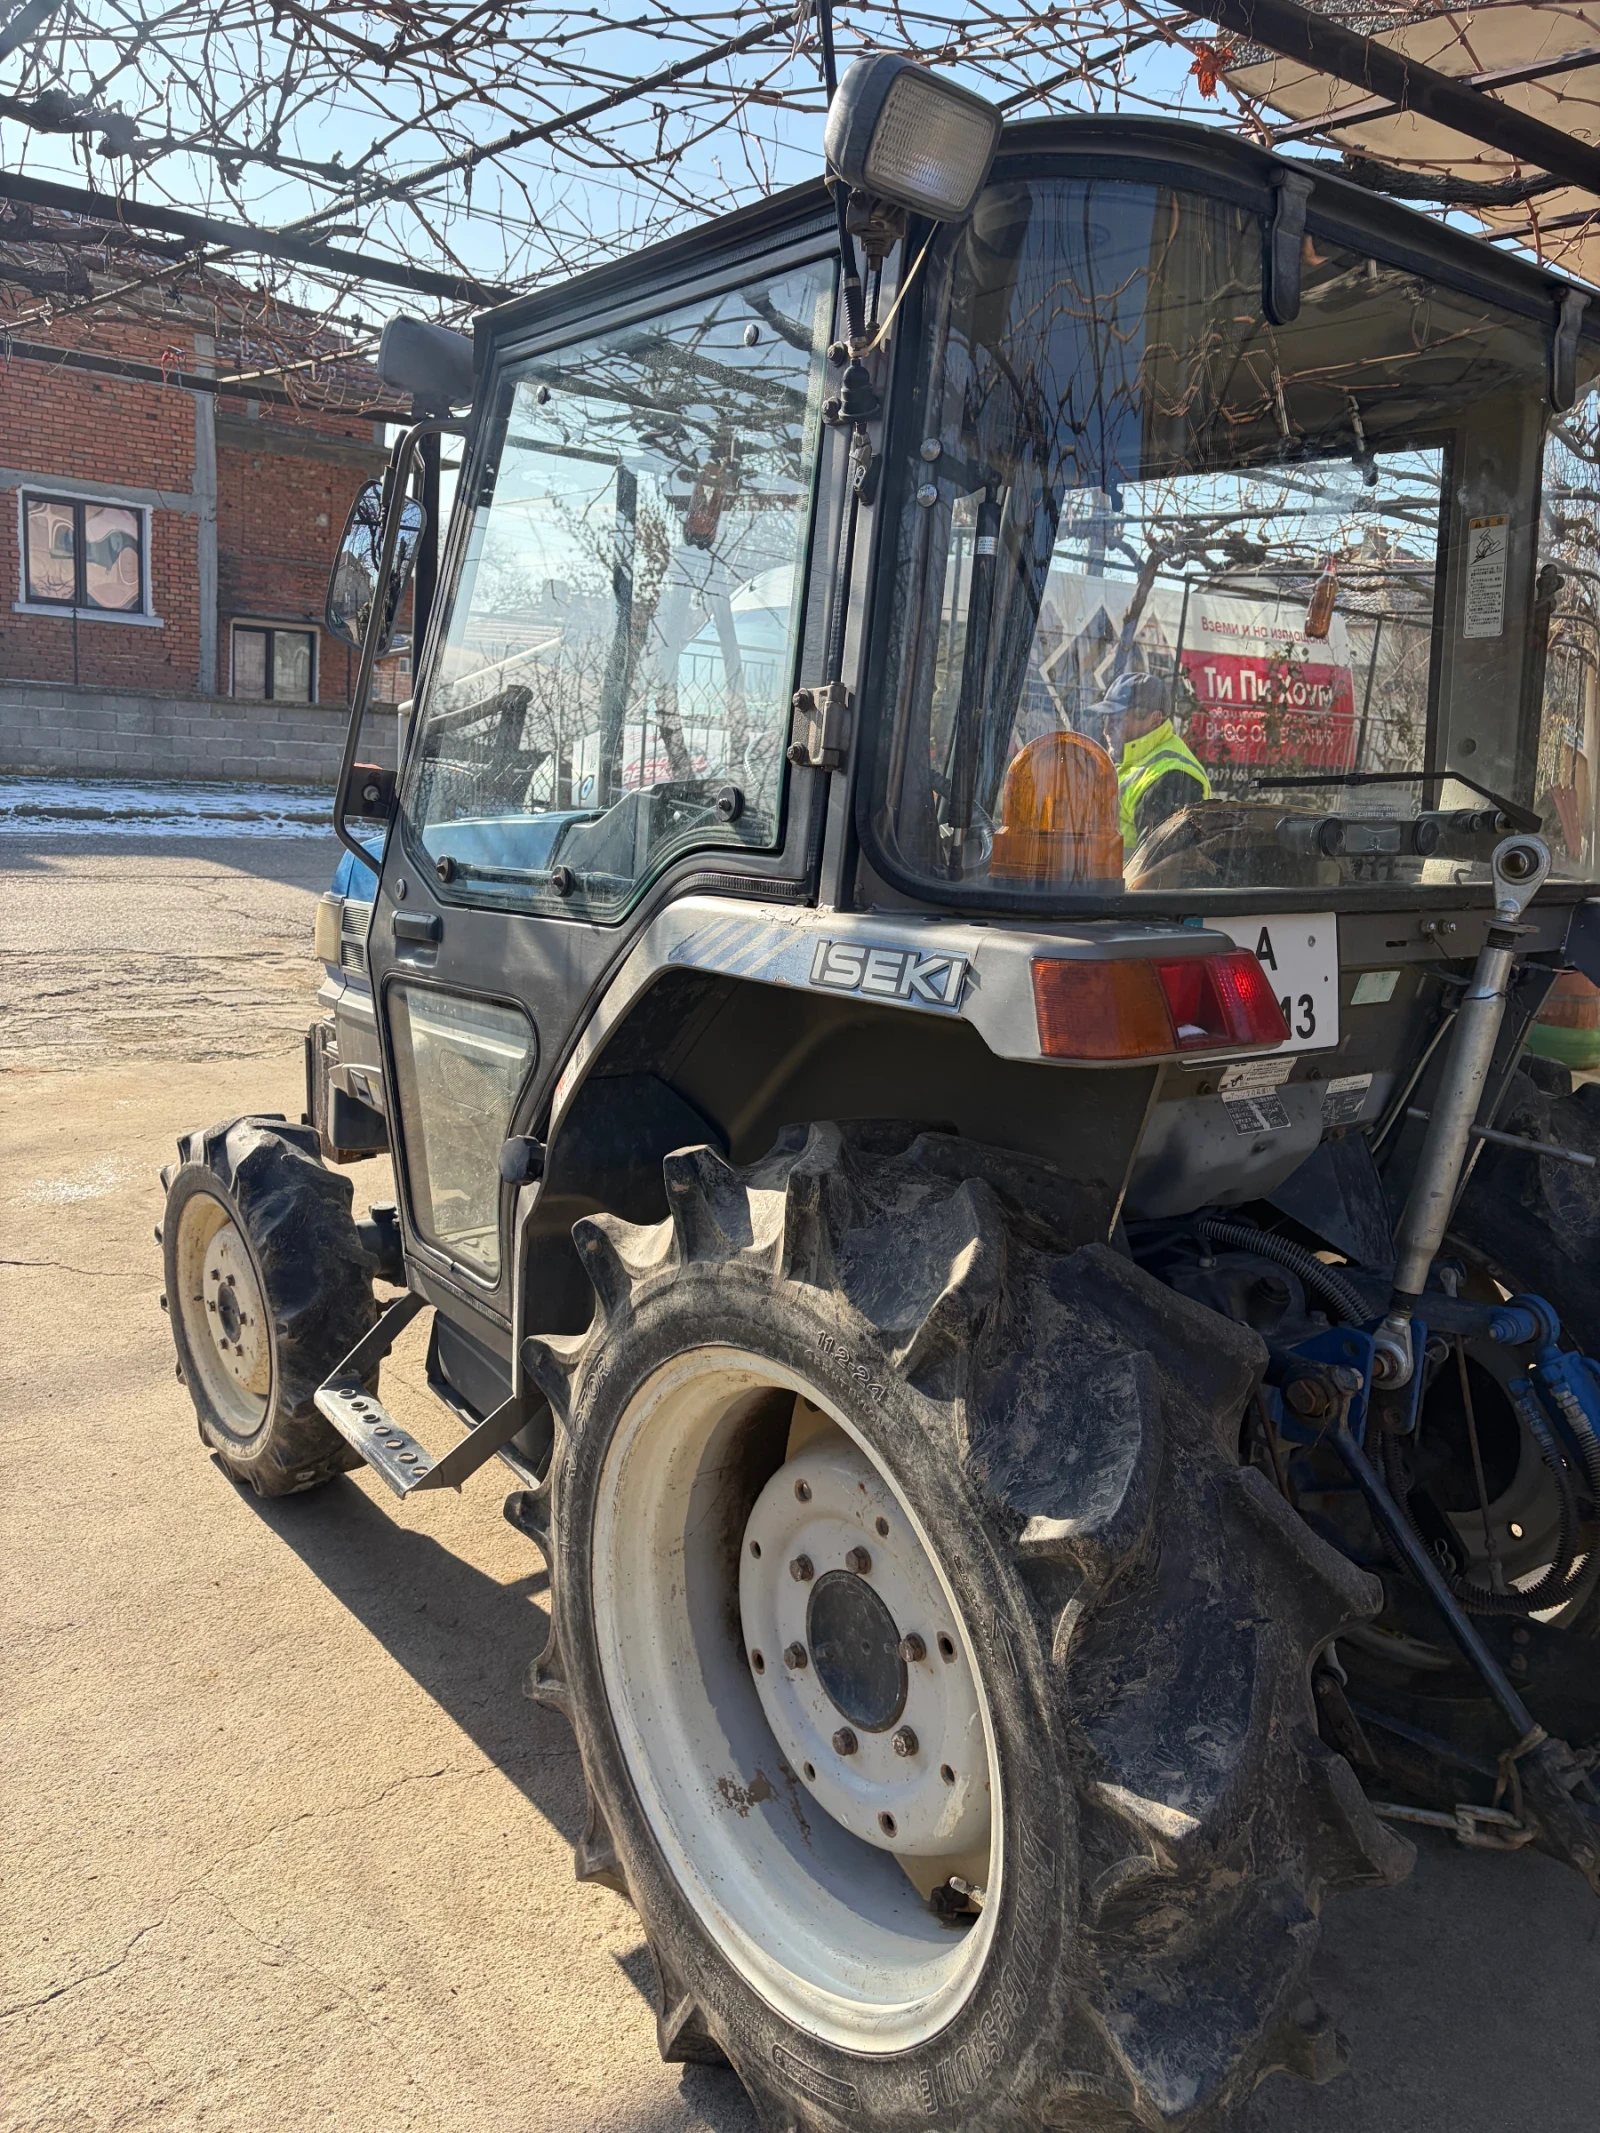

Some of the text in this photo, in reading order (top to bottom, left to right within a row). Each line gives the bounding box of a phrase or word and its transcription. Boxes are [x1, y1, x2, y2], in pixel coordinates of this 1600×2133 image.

[1201, 616, 1238, 633] Вземи
[1242, 625, 1250, 634] и
[1254, 626, 1268, 638] на
[1204, 666, 1333, 707] Ти Пи Хоум
[1255, 926, 1278, 971] A
[810, 939, 967, 1006] ISEKI
[816, 1330, 886, 1402] 11.2-24
